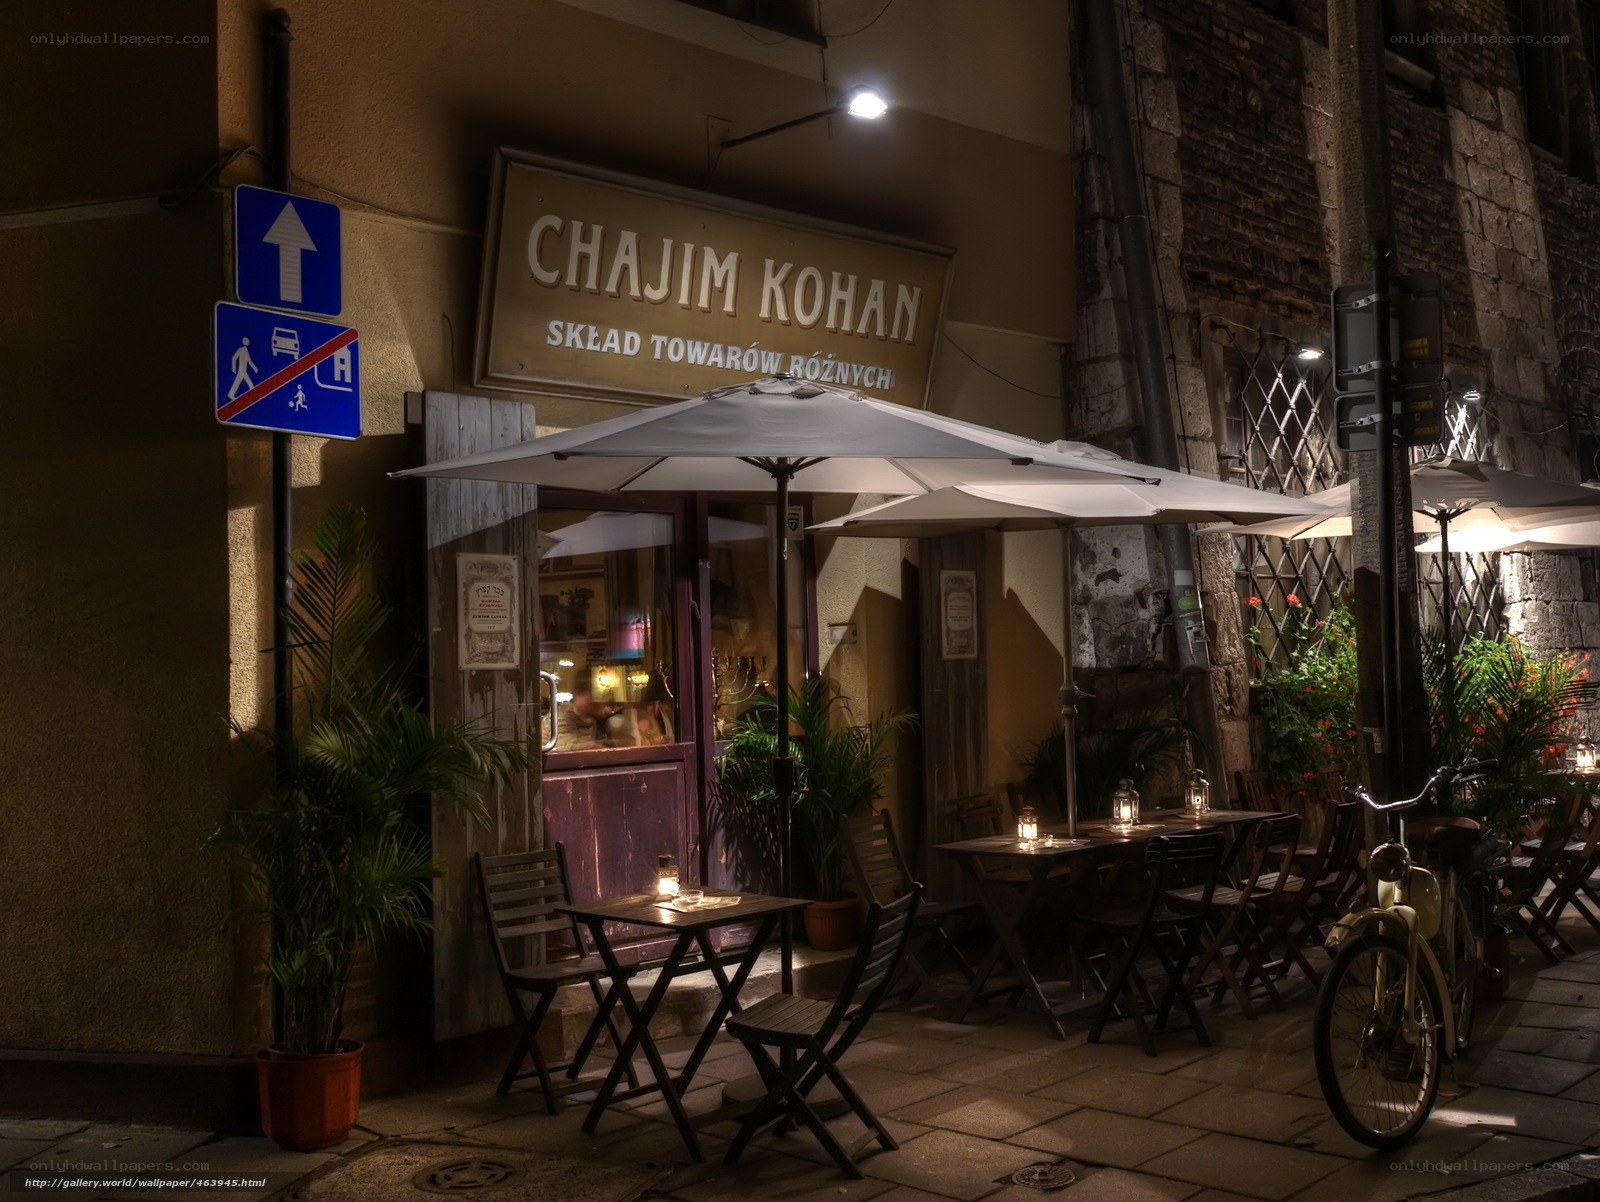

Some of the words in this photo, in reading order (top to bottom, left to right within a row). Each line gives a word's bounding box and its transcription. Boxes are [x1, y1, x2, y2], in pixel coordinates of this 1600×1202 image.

[528, 214, 741, 315] CHAJIM
[759, 258, 923, 344] KOHAN
[547, 319, 641, 356] SKŁAD
[651, 334, 783, 375] TOWARÓW
[790, 351, 894, 390] RÓŻNYCH
